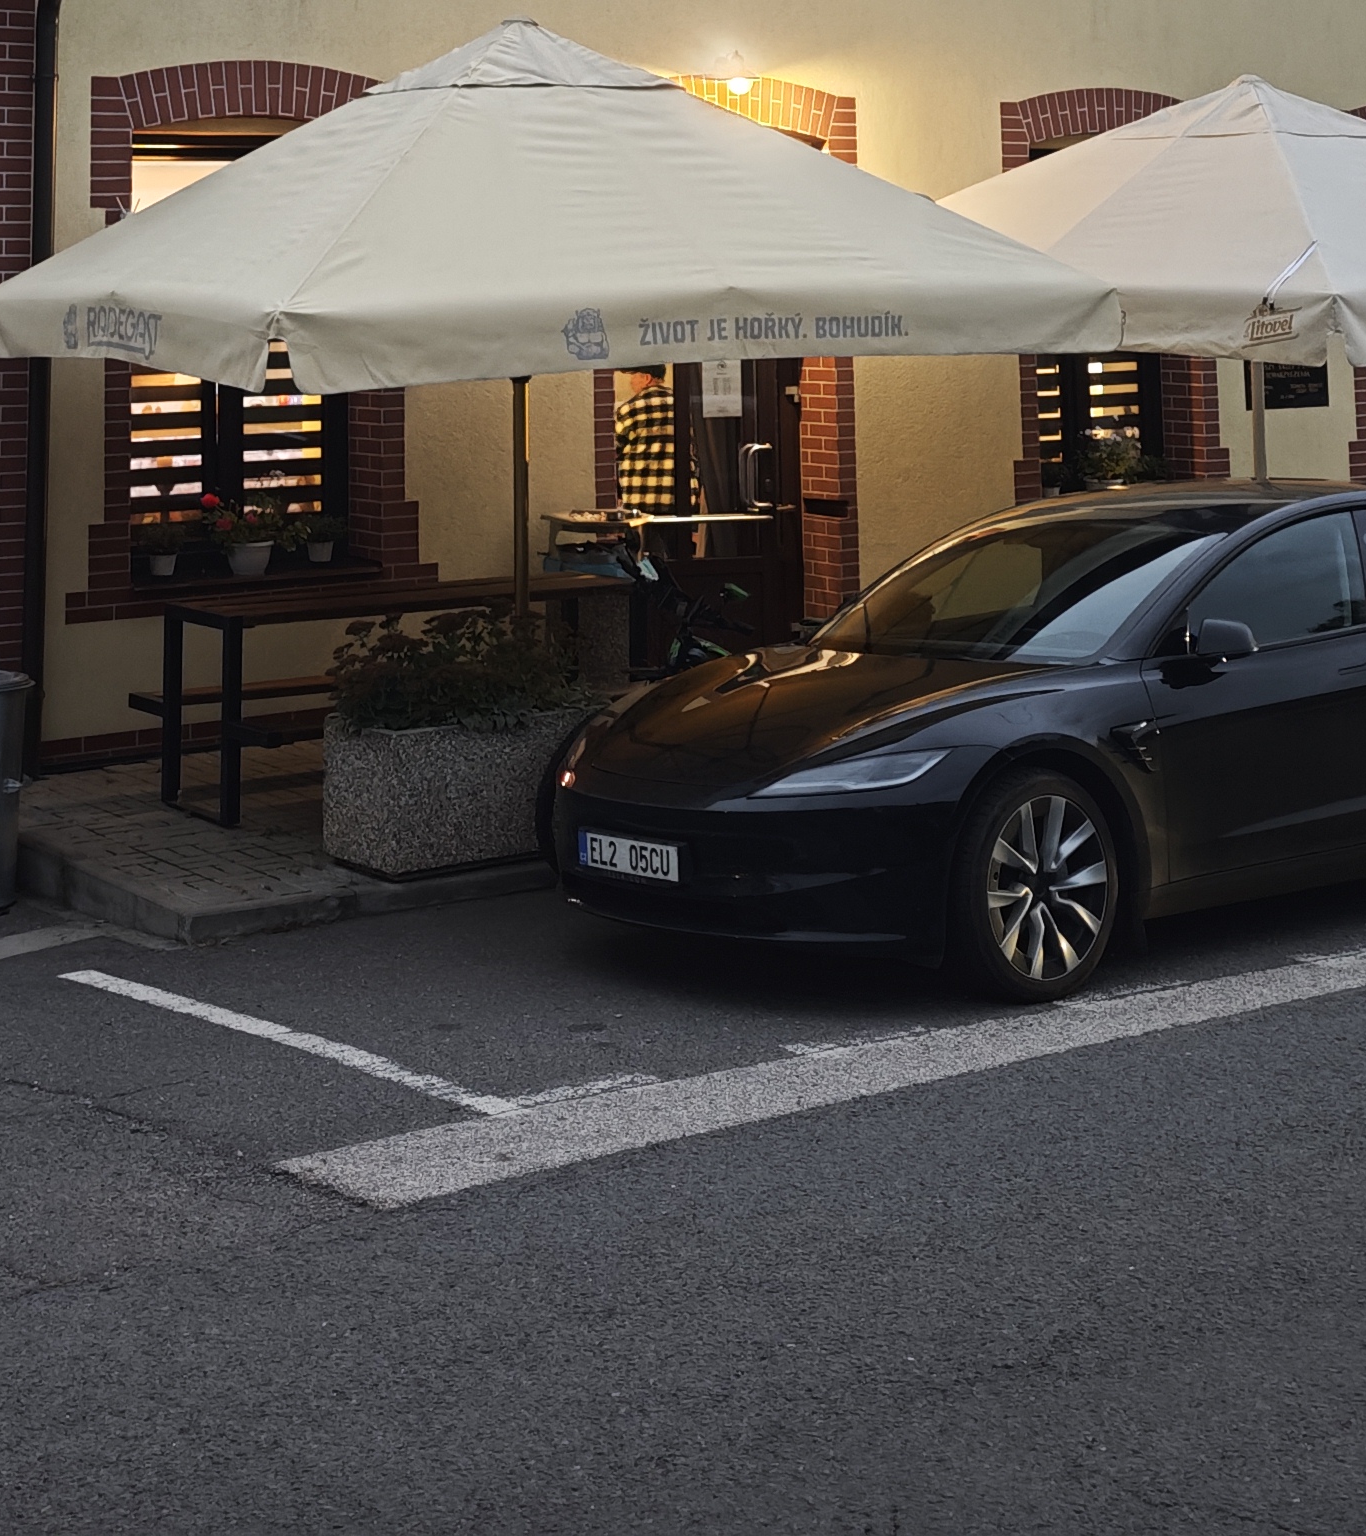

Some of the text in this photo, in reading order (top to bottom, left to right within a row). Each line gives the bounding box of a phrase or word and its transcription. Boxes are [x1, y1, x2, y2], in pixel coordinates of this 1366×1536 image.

[86, 306, 162, 360] RADEGAST
[638, 311, 910, 346] ŽIVOT JE HOŘKÝ. BOHUDÍK.
[1248, 314, 1295, 342] Litovel
[589, 837, 618, 869] EL2
[629, 844, 670, 877] 05CU
